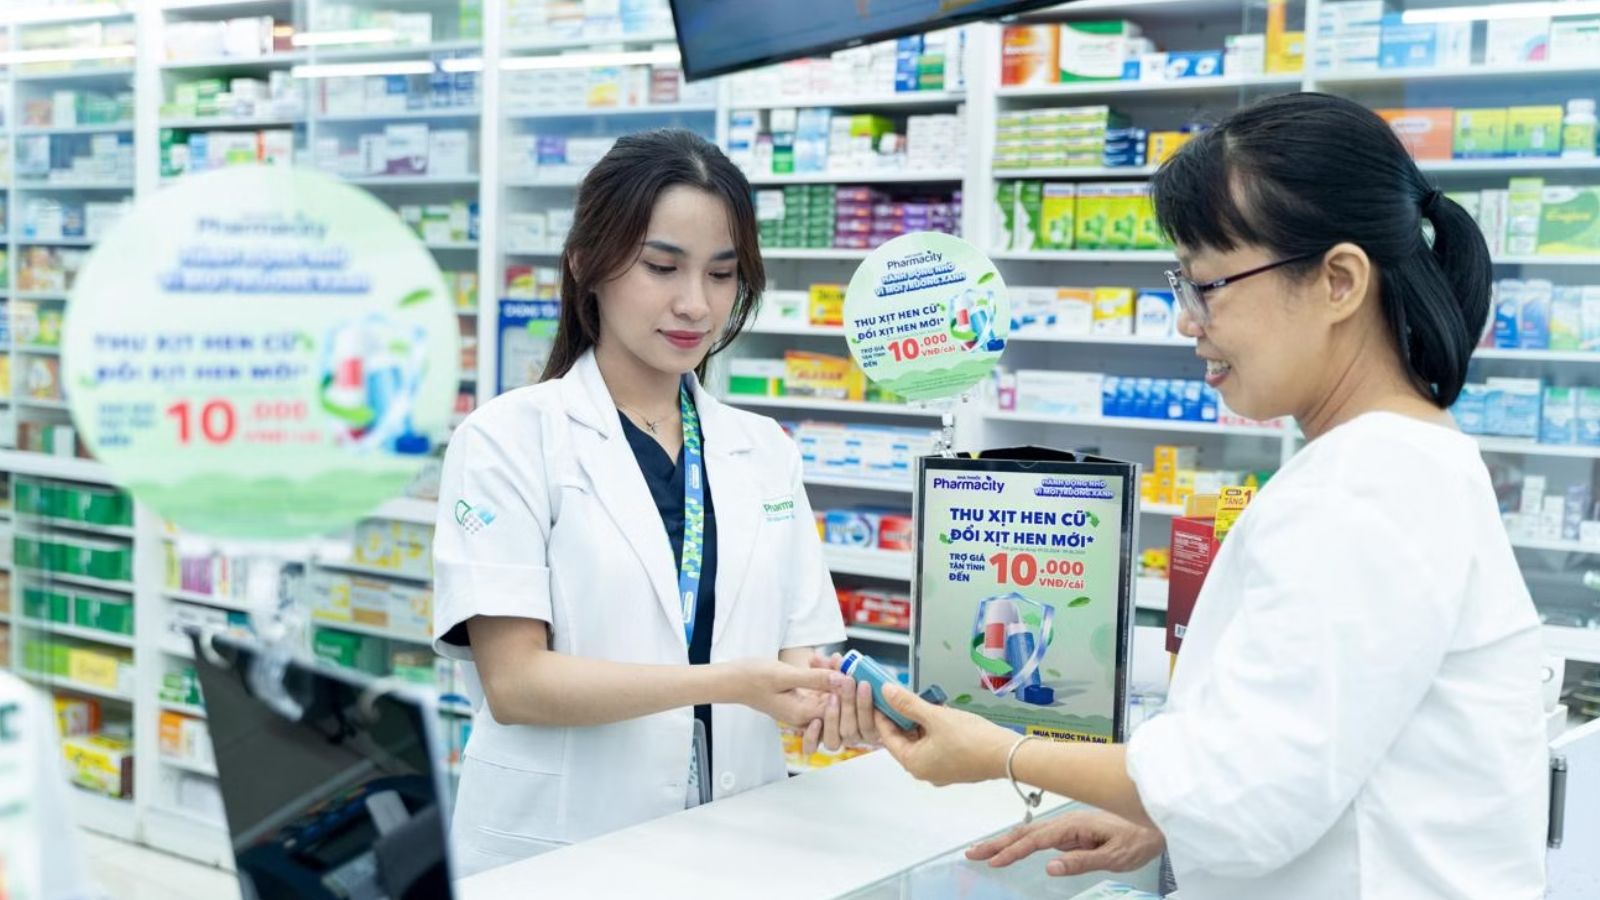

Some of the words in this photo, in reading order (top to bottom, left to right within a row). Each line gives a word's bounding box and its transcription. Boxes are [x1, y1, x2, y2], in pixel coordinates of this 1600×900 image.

[887, 250, 943, 269] Pharmacity
[854, 317, 876, 328] THU
[879, 313, 896, 326] XỊT
[898, 309, 920, 319] HEN
[858, 328, 876, 340] ĐỔI
[879, 327, 894, 338] XỊT
[897, 323, 918, 333] HEN
[933, 476, 1005, 493] Pharmacity
[1244, 489, 1253, 505] 1
[950, 508, 984, 522] THU
[988, 510, 1018, 526] XỊT
[1021, 511, 1056, 526] HEN
[1061, 510, 1087, 527] CŨ
[950, 524, 980, 542] ĐỔI
[984, 530, 1010, 546] XỊT
[1013, 532, 1047, 546] HEN
[949, 552, 968, 563] TRỢ
[969, 552, 986, 562] GIÁ
[967, 563, 985, 571] TÌNH
[949, 571, 970, 582] ĐẾN
[1039, 577, 1085, 590] VNĐ/cái
[1032, 729, 1051, 738] MUA
[1076, 733, 1092, 742] TRẢ
[1091, 735, 1108, 744] SAU
